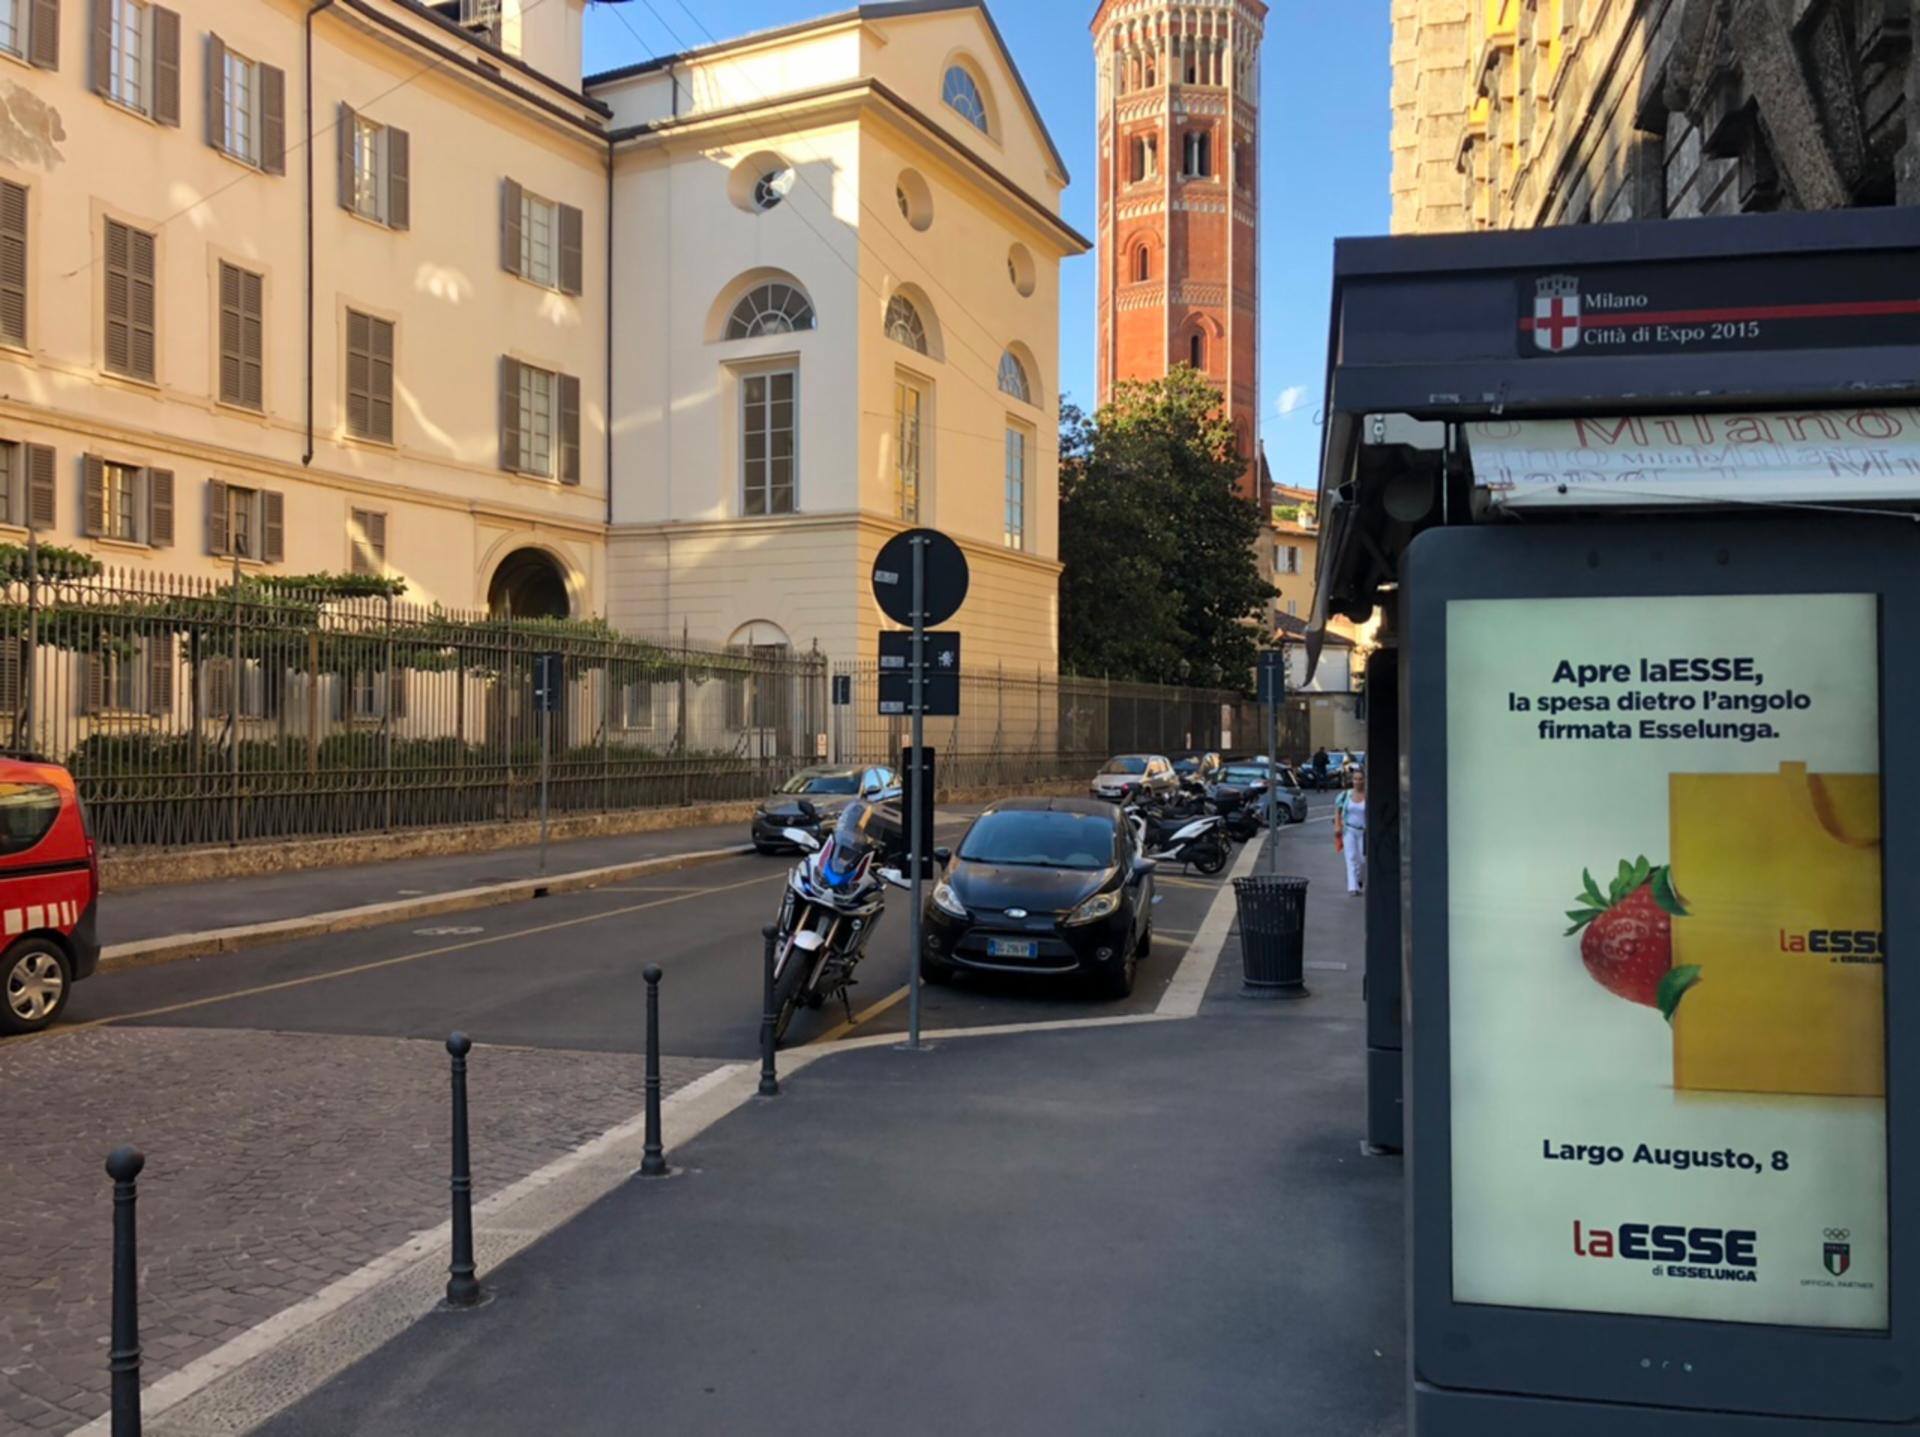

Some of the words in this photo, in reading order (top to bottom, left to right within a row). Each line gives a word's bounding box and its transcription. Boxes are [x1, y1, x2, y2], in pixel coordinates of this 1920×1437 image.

[1585, 293, 1648, 309] Milano
[1584, 327, 1626, 344] Città
[1634, 326, 1650, 343] di
[1656, 326, 1705, 347] Expo
[1711, 321, 1760, 340] 2015
[1552, 659, 1631, 687] Apre
[1640, 658, 1764, 686] laESSE,
[1509, 692, 1531, 712] la
[1537, 696, 1611, 716] spesa
[1616, 691, 1697, 711] dietro
[1538, 720, 1632, 740] firmata
[1639, 719, 1780, 742] Esselunga.
[1543, 1140, 1625, 1166] Largo
[1632, 1143, 1763, 1174] Augusto,
[1770, 1151, 1790, 1171] 8
[1573, 1220, 1758, 1267] laESSE
[1652, 1265, 1664, 1277] di
[1667, 1265, 1757, 1282] ESSELUNGA
